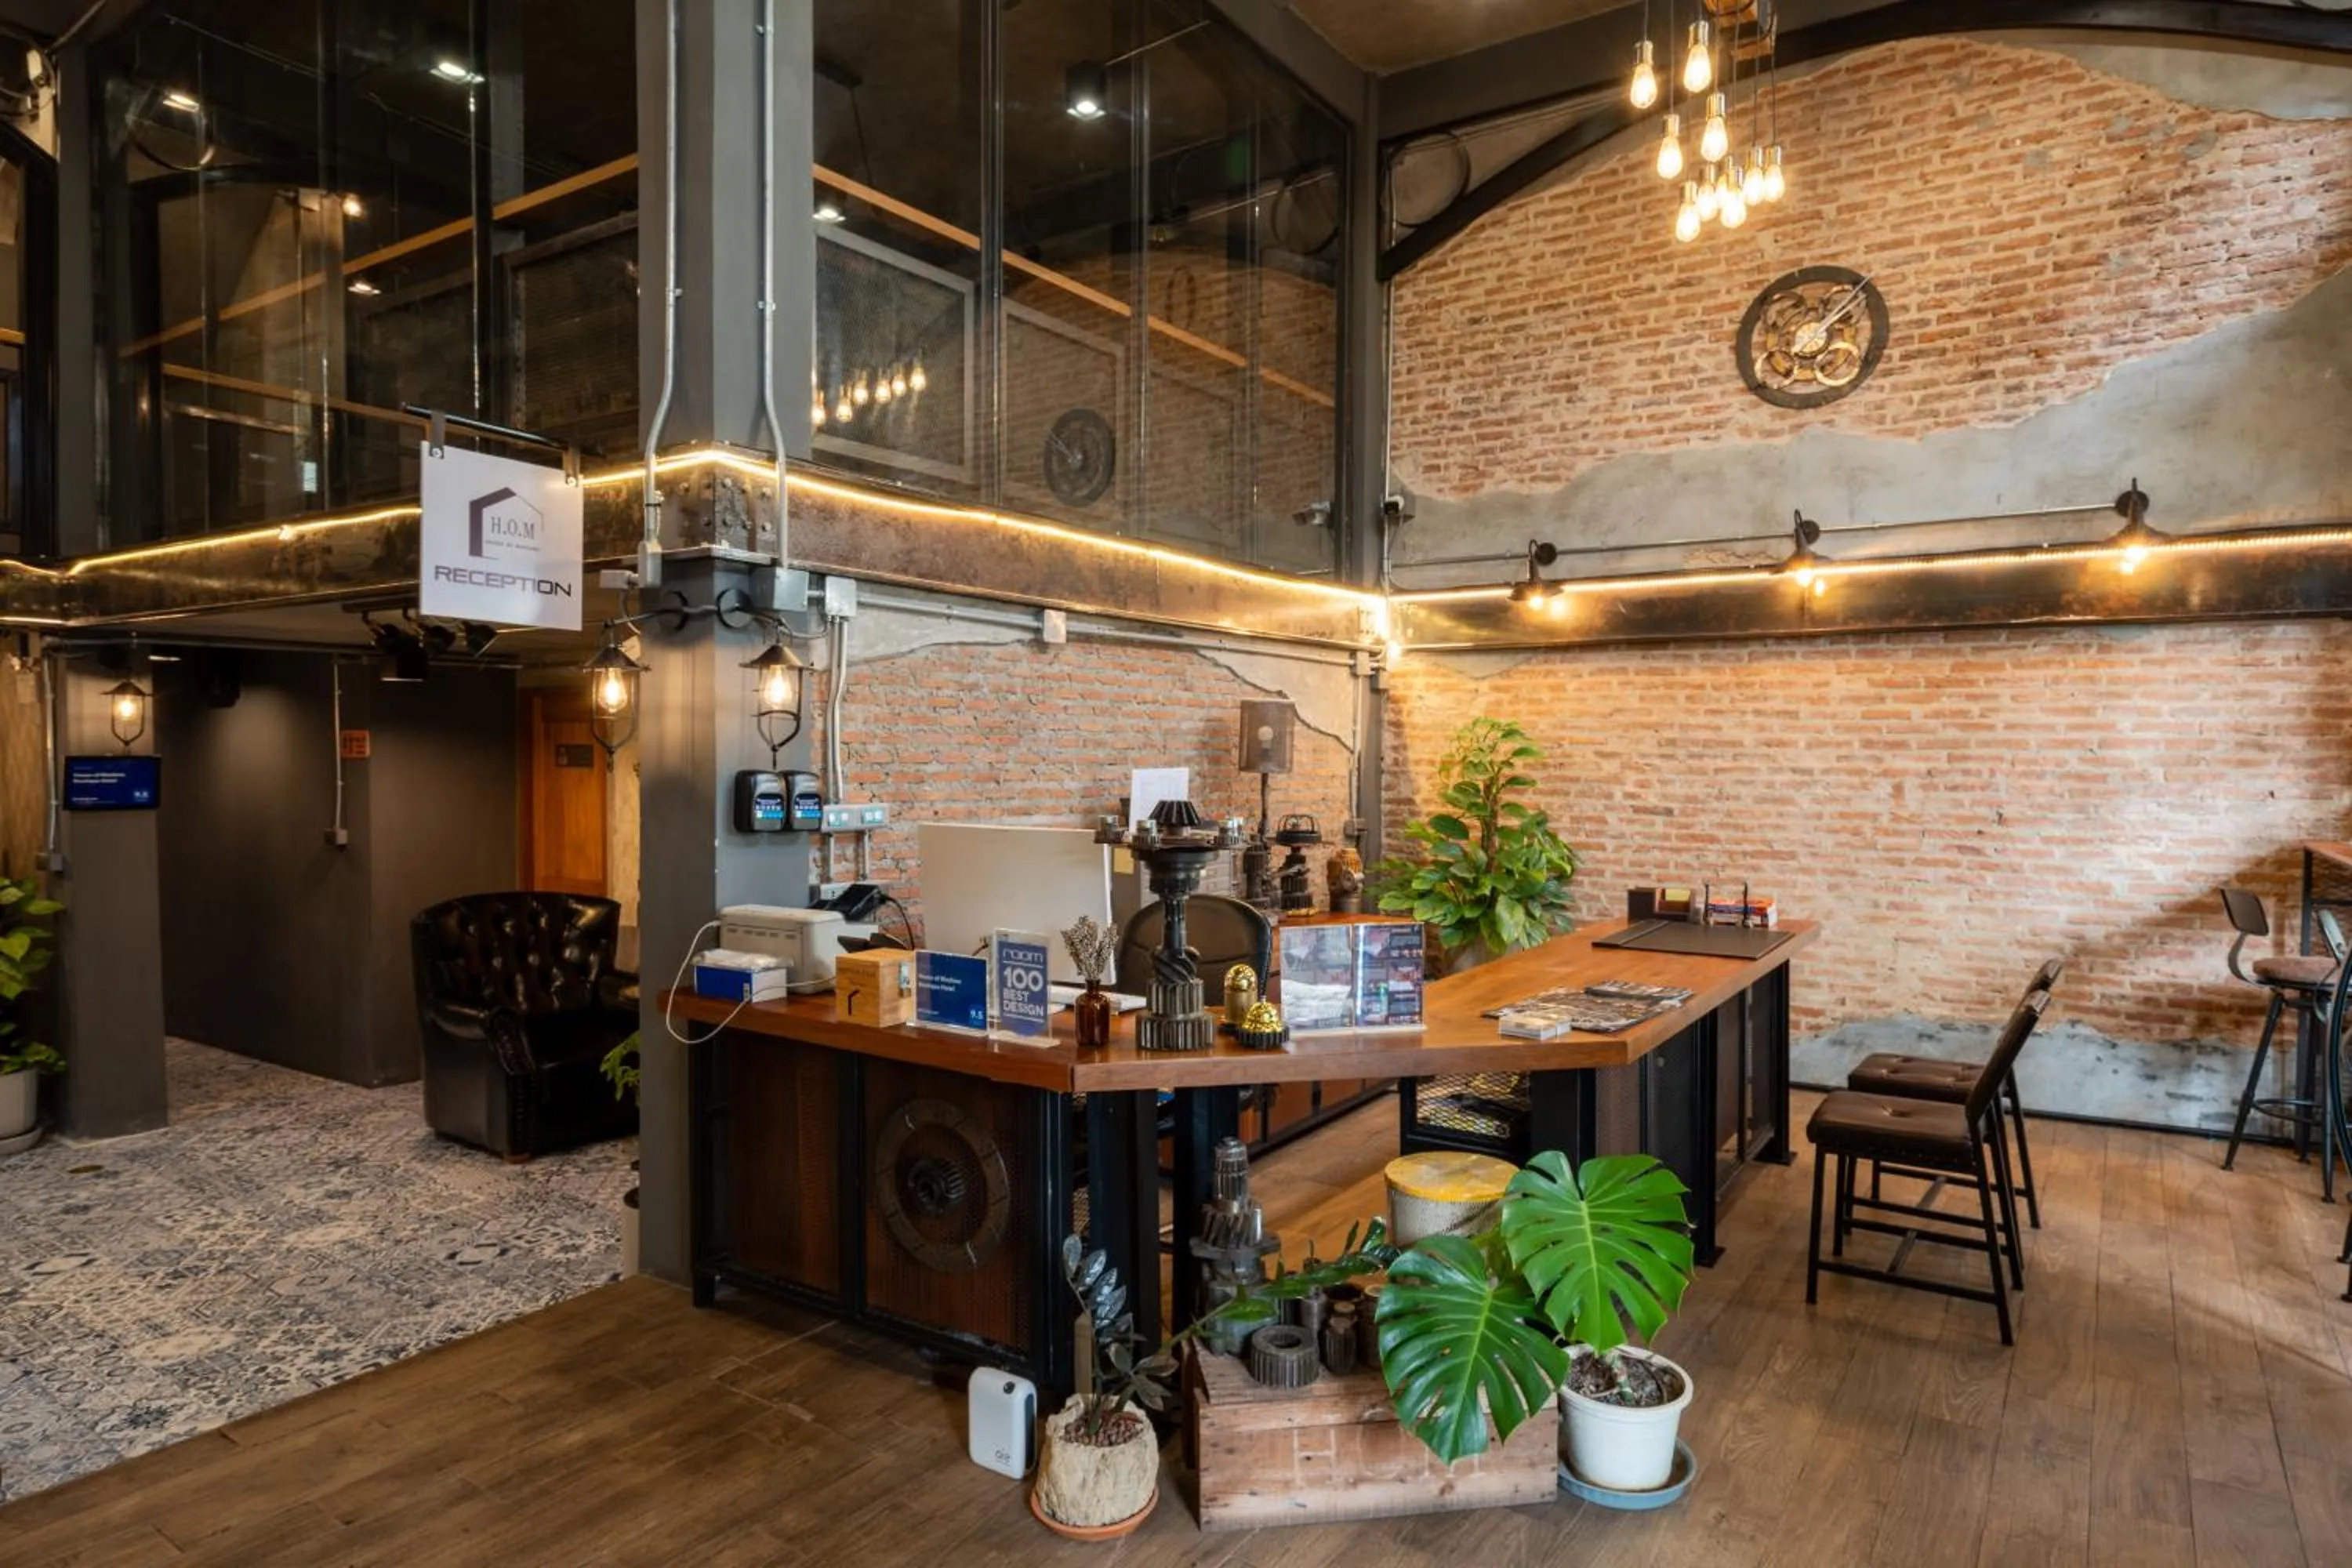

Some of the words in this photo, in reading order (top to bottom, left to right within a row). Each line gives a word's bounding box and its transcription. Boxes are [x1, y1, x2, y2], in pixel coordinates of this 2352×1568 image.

[491, 516, 535, 539] H.O.M
[434, 564, 572, 597] RECEPTION
[1004, 966, 1044, 992] 100
[1004, 988, 1029, 1003] BEST
[1004, 1000, 1044, 1017] DESIGN
